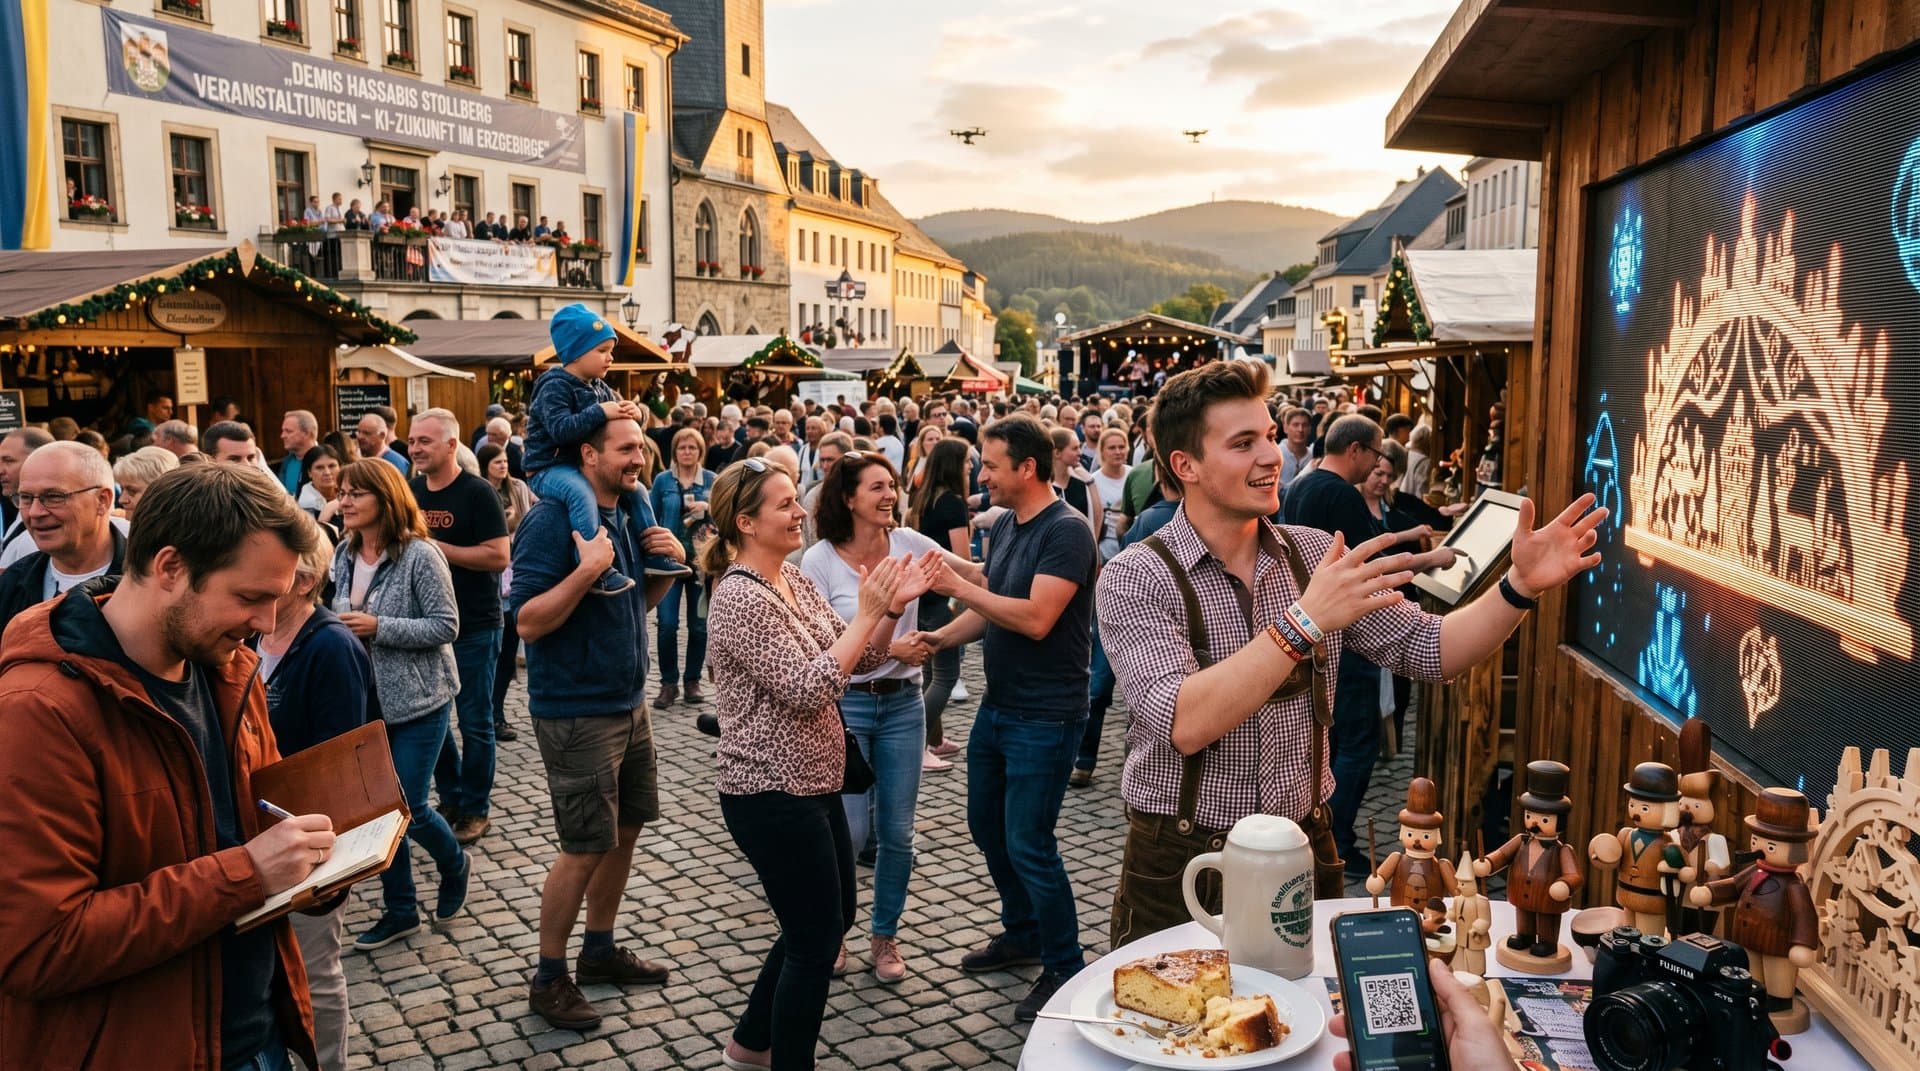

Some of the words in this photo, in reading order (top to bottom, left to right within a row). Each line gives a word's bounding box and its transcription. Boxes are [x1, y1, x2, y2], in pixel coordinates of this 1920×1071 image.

[193, 72, 357, 126] VERANSTALTUNGEN
[375, 109, 456, 143] KI-ZUKUNFT
[458, 126, 474, 146] IM
[347, 74, 418, 109] HASSABIS
[421, 91, 492, 124] STOLLBERG
[1660, 960, 1694, 980] FUJIFILM
